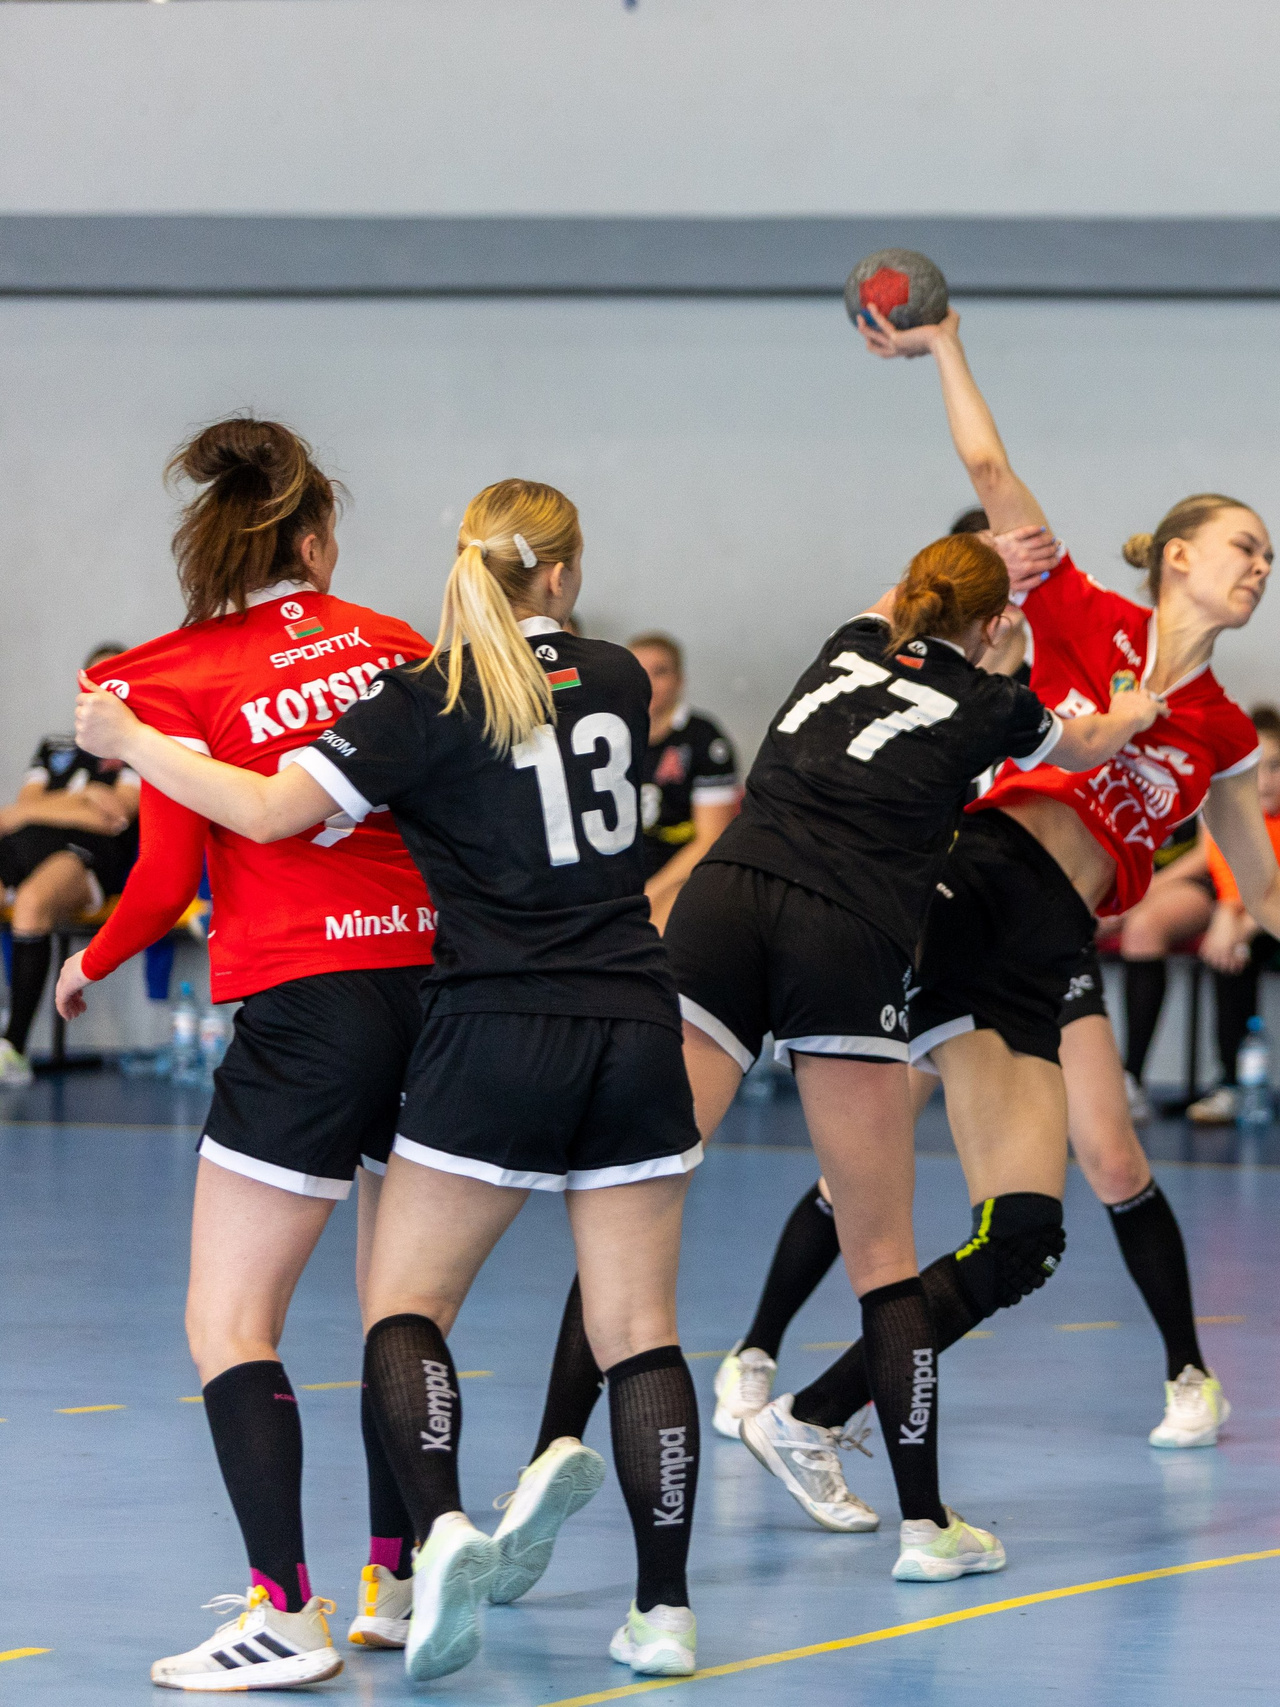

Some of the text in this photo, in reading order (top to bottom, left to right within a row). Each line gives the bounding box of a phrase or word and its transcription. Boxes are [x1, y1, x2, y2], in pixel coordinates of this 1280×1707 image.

[269, 627, 371, 669] SPORTIX
[240, 653, 407, 744] KOTSI
[776, 651, 959, 761] 77
[511, 712, 638, 866] 13
[325, 905, 411, 941] Minsk
[422, 1359, 458, 1452] Kempa
[899, 1348, 937, 1445] Kempa
[654, 1426, 693, 1526] Kempa
